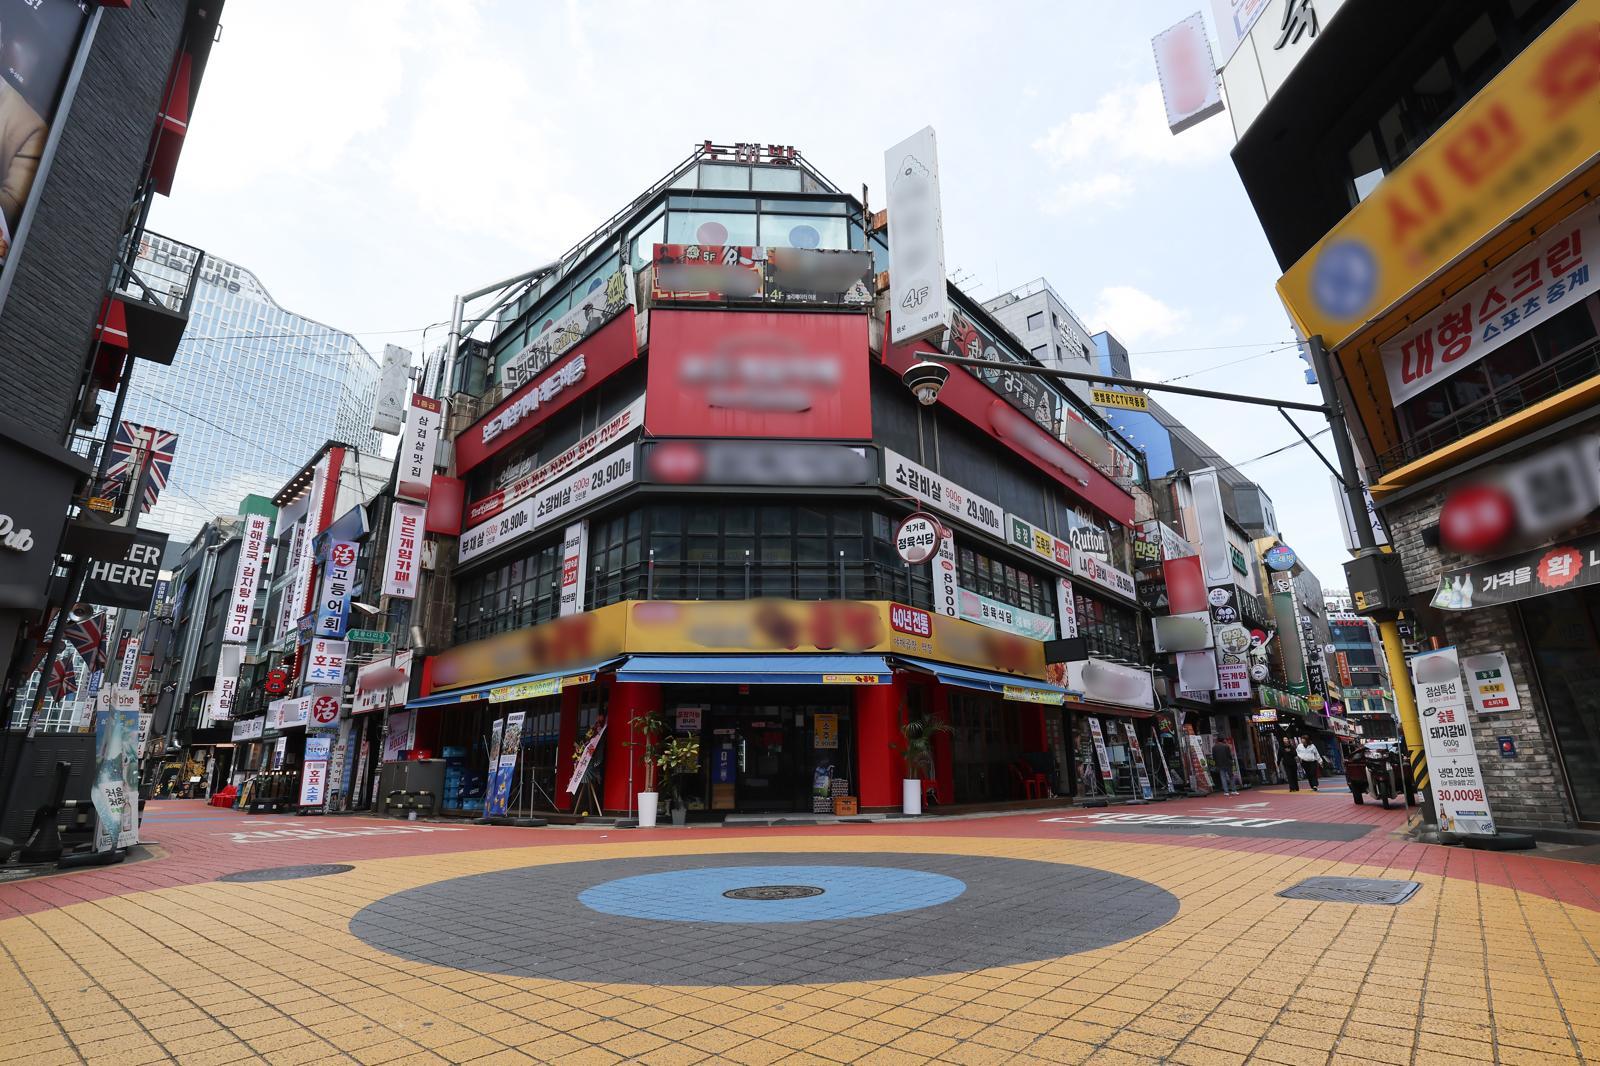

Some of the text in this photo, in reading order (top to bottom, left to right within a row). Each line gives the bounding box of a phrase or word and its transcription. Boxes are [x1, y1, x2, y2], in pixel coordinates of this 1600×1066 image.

[703, 251, 716, 262] 5F
[902, 286, 929, 309] 4F
[1400, 228, 1583, 385] 대형스크린
[1482, 263, 1590, 343] 스포츠 중계
[1093, 391, 1146, 408] 방범용CCTV작동중
[411, 415, 430, 478] 삼겹살맛집
[895, 463, 942, 503] 소갈비살
[945, 487, 962, 505] 500g
[536, 485, 572, 518] 소갈비살
[573, 477, 590, 492] 500g
[905, 521, 926, 532] 직거래
[1015, 522, 1028, 543] 농장
[394, 515, 416, 581] 보드게임카페
[462, 532, 485, 555] 부채살
[898, 532, 934, 550] 정육식당
[1070, 526, 1105, 551] Button
[1135, 541, 1158, 560] 만화
[91, 561, 156, 587] HERE
[231, 519, 265, 637] 뼈해장국 감자탕 뼈구이
[1482, 553, 1573, 592] 가격을 확
[323, 569, 349, 632] 고등어회
[892, 606, 929, 636] 40년 전통
[982, 603, 1013, 624] 정육식당
[312, 655, 343, 667] 호프
[310, 668, 341, 679] 소주
[219, 679, 235, 709] 감자탕
[1222, 682, 1241, 690] 카페
[1425, 683, 1457, 697] 점심특선
[316, 698, 337, 722] 活
[1436, 709, 1455, 723] 숯불
[1430, 724, 1467, 739] 돼지갈비
[1442, 739, 1460, 749] 600g
[308, 770, 321, 786] 호프
[1438, 767, 1475, 778] 냉면 2인분
[105, 786, 123, 797] 처음
[306, 786, 319, 803] 소주
[1437, 789, 1484, 803] 30,000원
